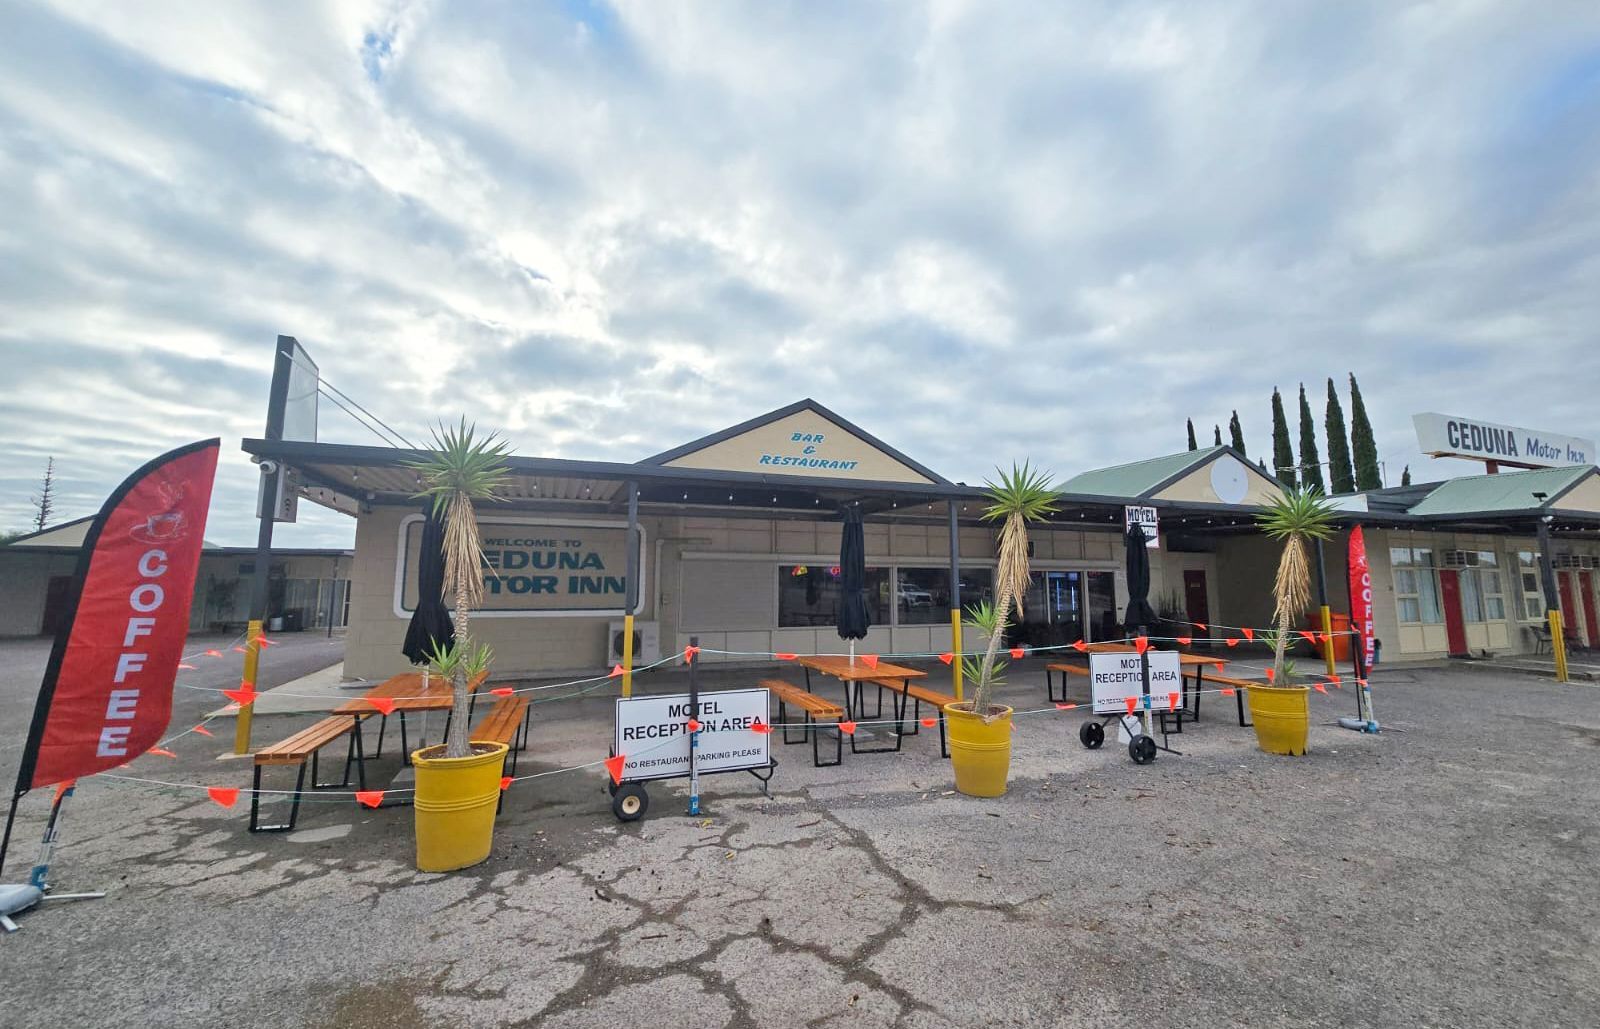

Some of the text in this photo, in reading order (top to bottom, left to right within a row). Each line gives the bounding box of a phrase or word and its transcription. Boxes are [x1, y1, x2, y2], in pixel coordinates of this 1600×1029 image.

[791, 432, 824, 443] BAR
[1447, 420, 1587, 464] CEDUNA Motor Inn
[803, 446, 816, 455] &
[760, 455, 858, 469] RESTAURANT
[1127, 508, 1156, 522] MOTEL
[484, 538, 582, 548] WELCOME TO
[480, 549, 605, 570] EDUNA
[483, 575, 559, 594] TOR
[1361, 572, 1375, 667] COFFEE
[96, 549, 168, 757] COFFEE
[1120, 659, 1153, 669] MOT
[1095, 671, 1177, 684] RECEPTIO AREA
[623, 719, 717, 741] RECEPTON
[624, 761, 638, 770] NO
[639, 756, 690, 768] RESTAURAN
[732, 747, 762, 759] PLEASE
